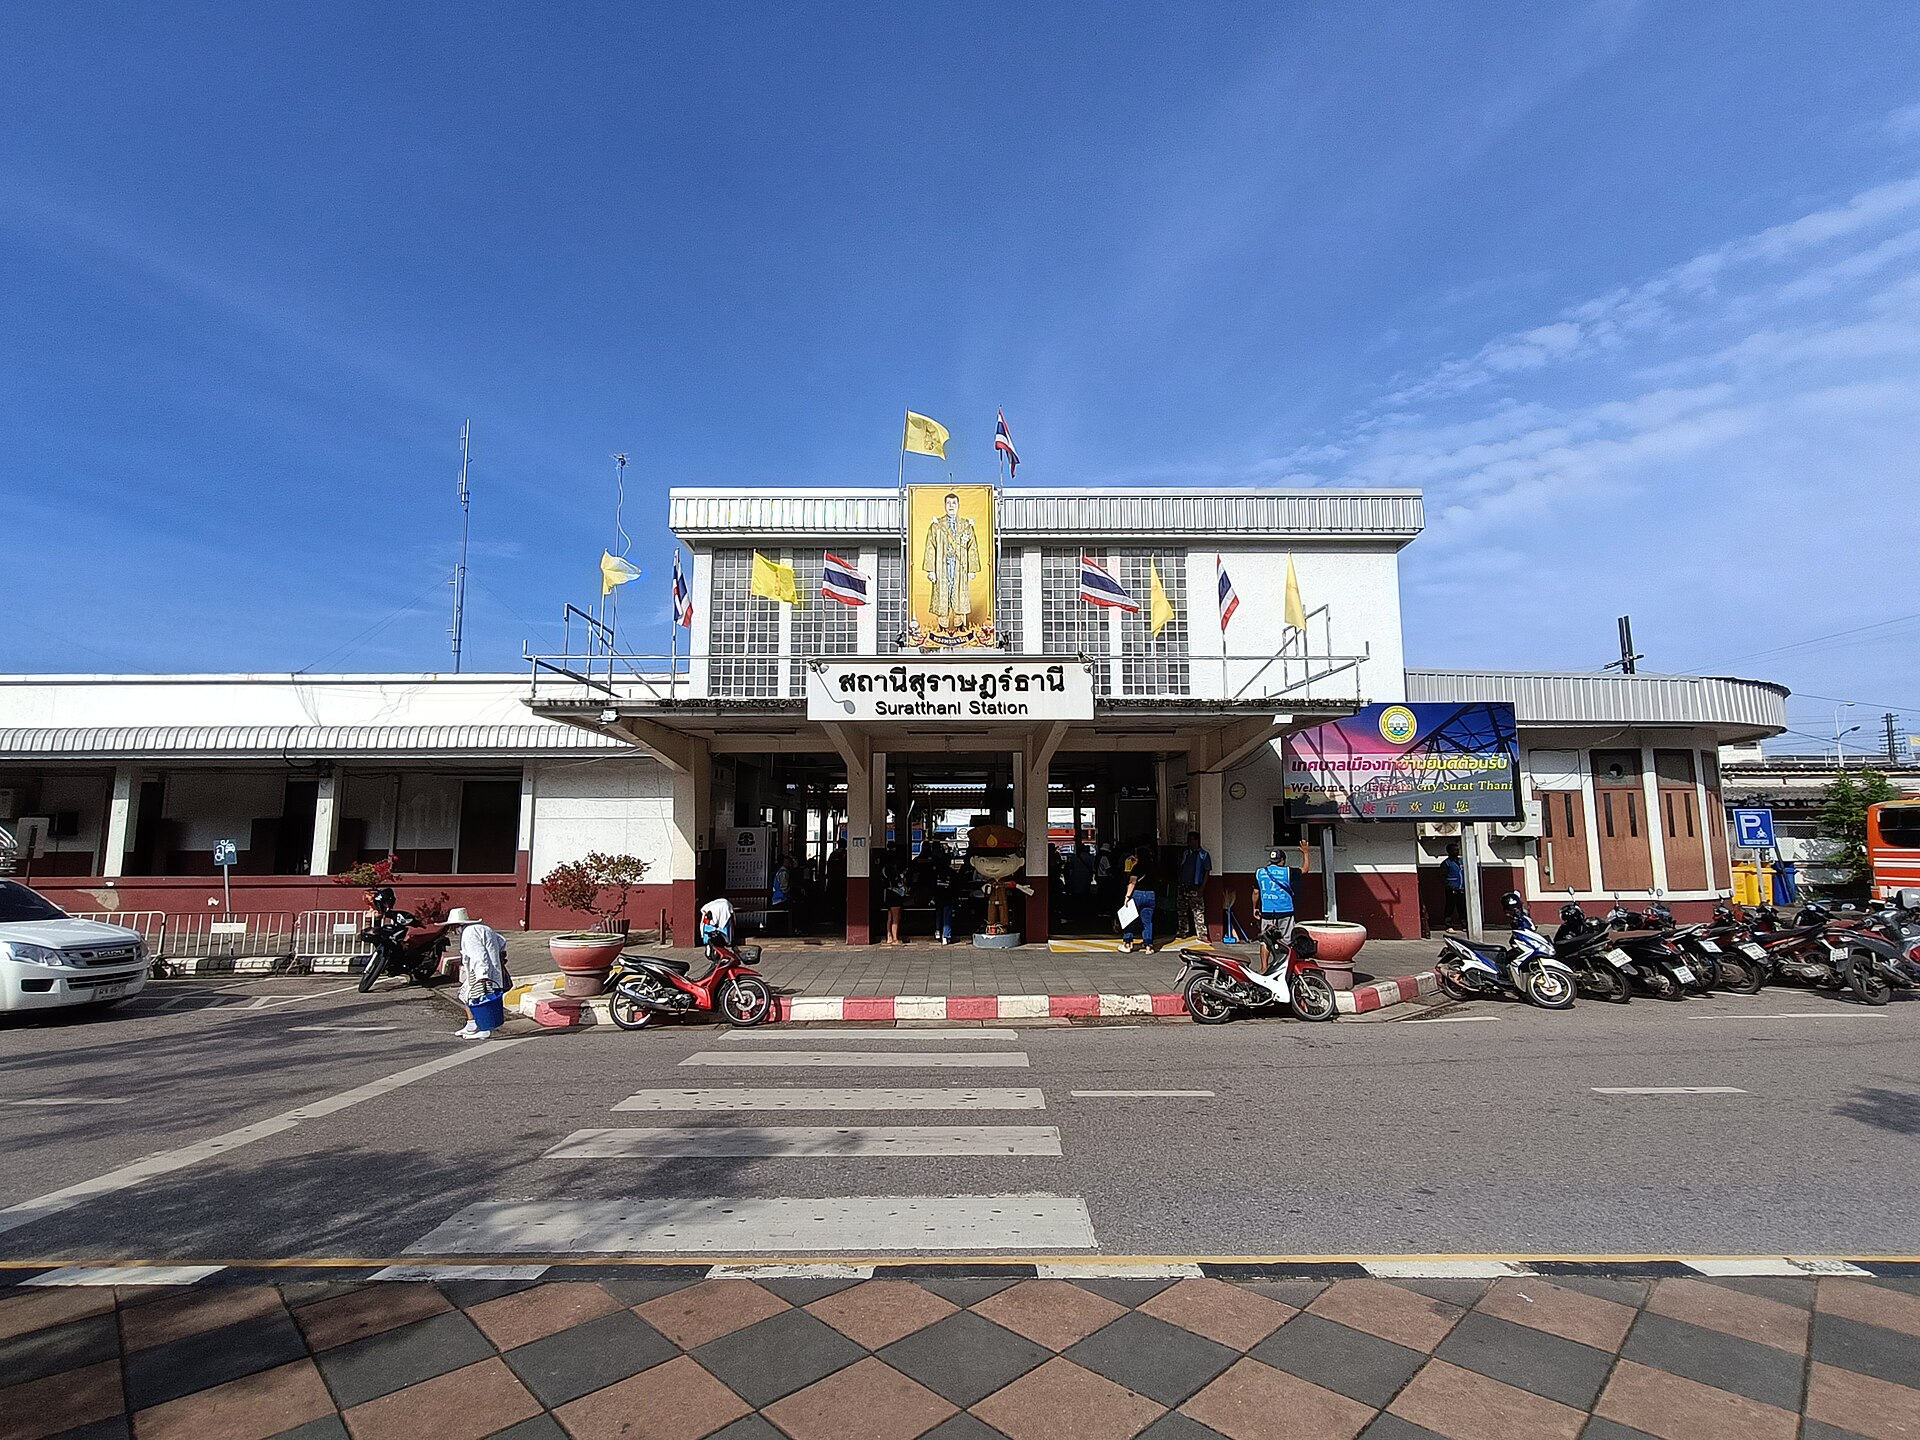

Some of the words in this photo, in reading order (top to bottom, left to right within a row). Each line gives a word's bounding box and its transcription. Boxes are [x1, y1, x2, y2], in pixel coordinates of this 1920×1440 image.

[838, 665, 1065, 699] สถานีสุราษฎร์ธานี
[875, 700, 962, 715] Suratthani
[968, 700, 1028, 715] Station
[1291, 755, 1508, 771] เทศบาลเมืองท่าข้ามยินดีต้อนรับ
[1291, 783, 1345, 792] Welcome
[1349, 784, 1360, 792] to
[1443, 781, 1474, 791] Surat
[1478, 780, 1513, 790] Thani
[1740, 815, 1761, 838] P
[98, 949, 125, 957] ISUZU
